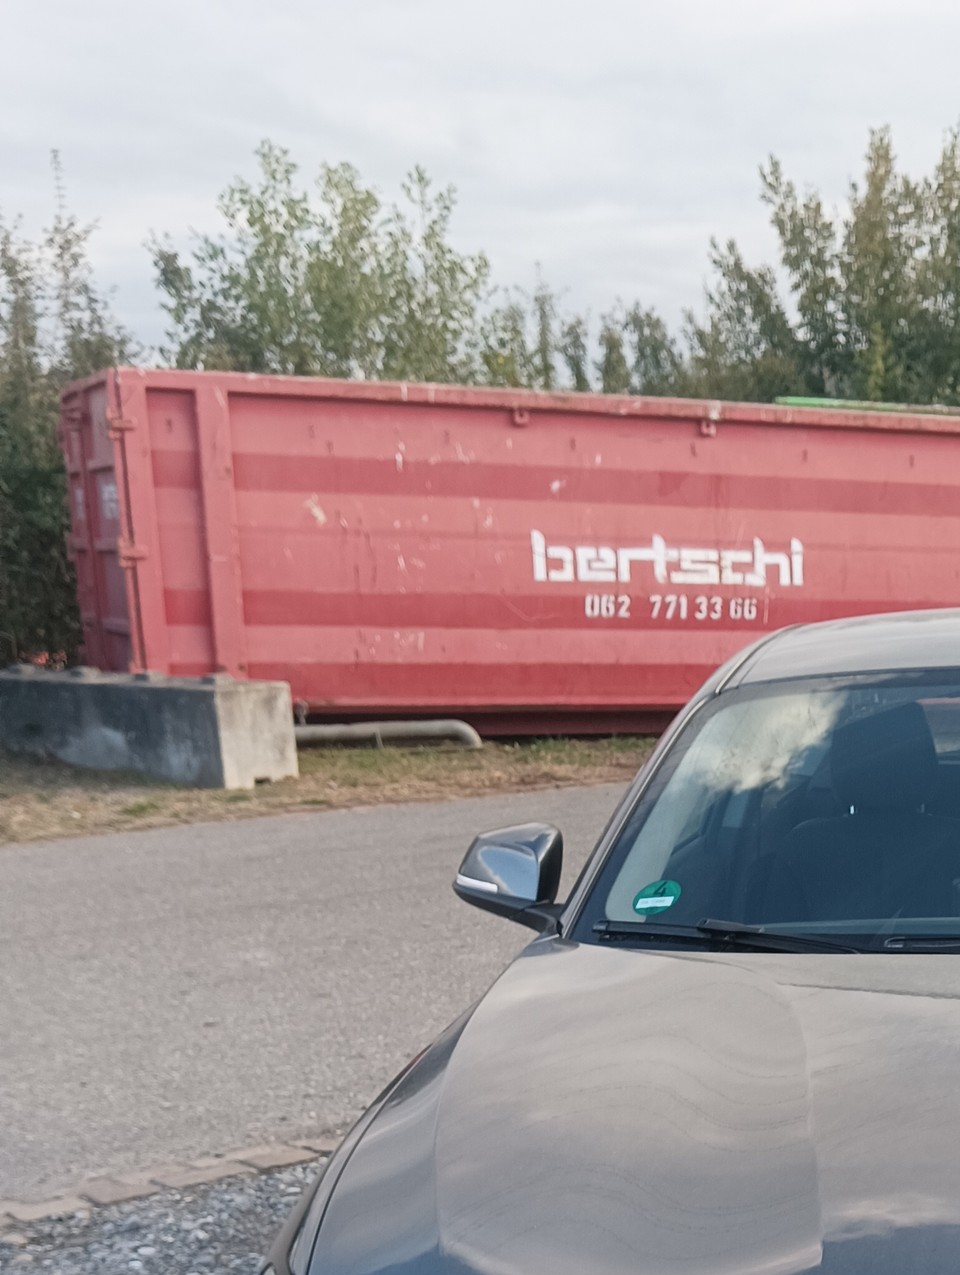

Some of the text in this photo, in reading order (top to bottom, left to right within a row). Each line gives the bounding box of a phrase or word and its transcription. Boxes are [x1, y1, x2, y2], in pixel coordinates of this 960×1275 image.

[530, 529, 804, 587] bertschi
[584, 594, 757, 621] 062 771 33 66
